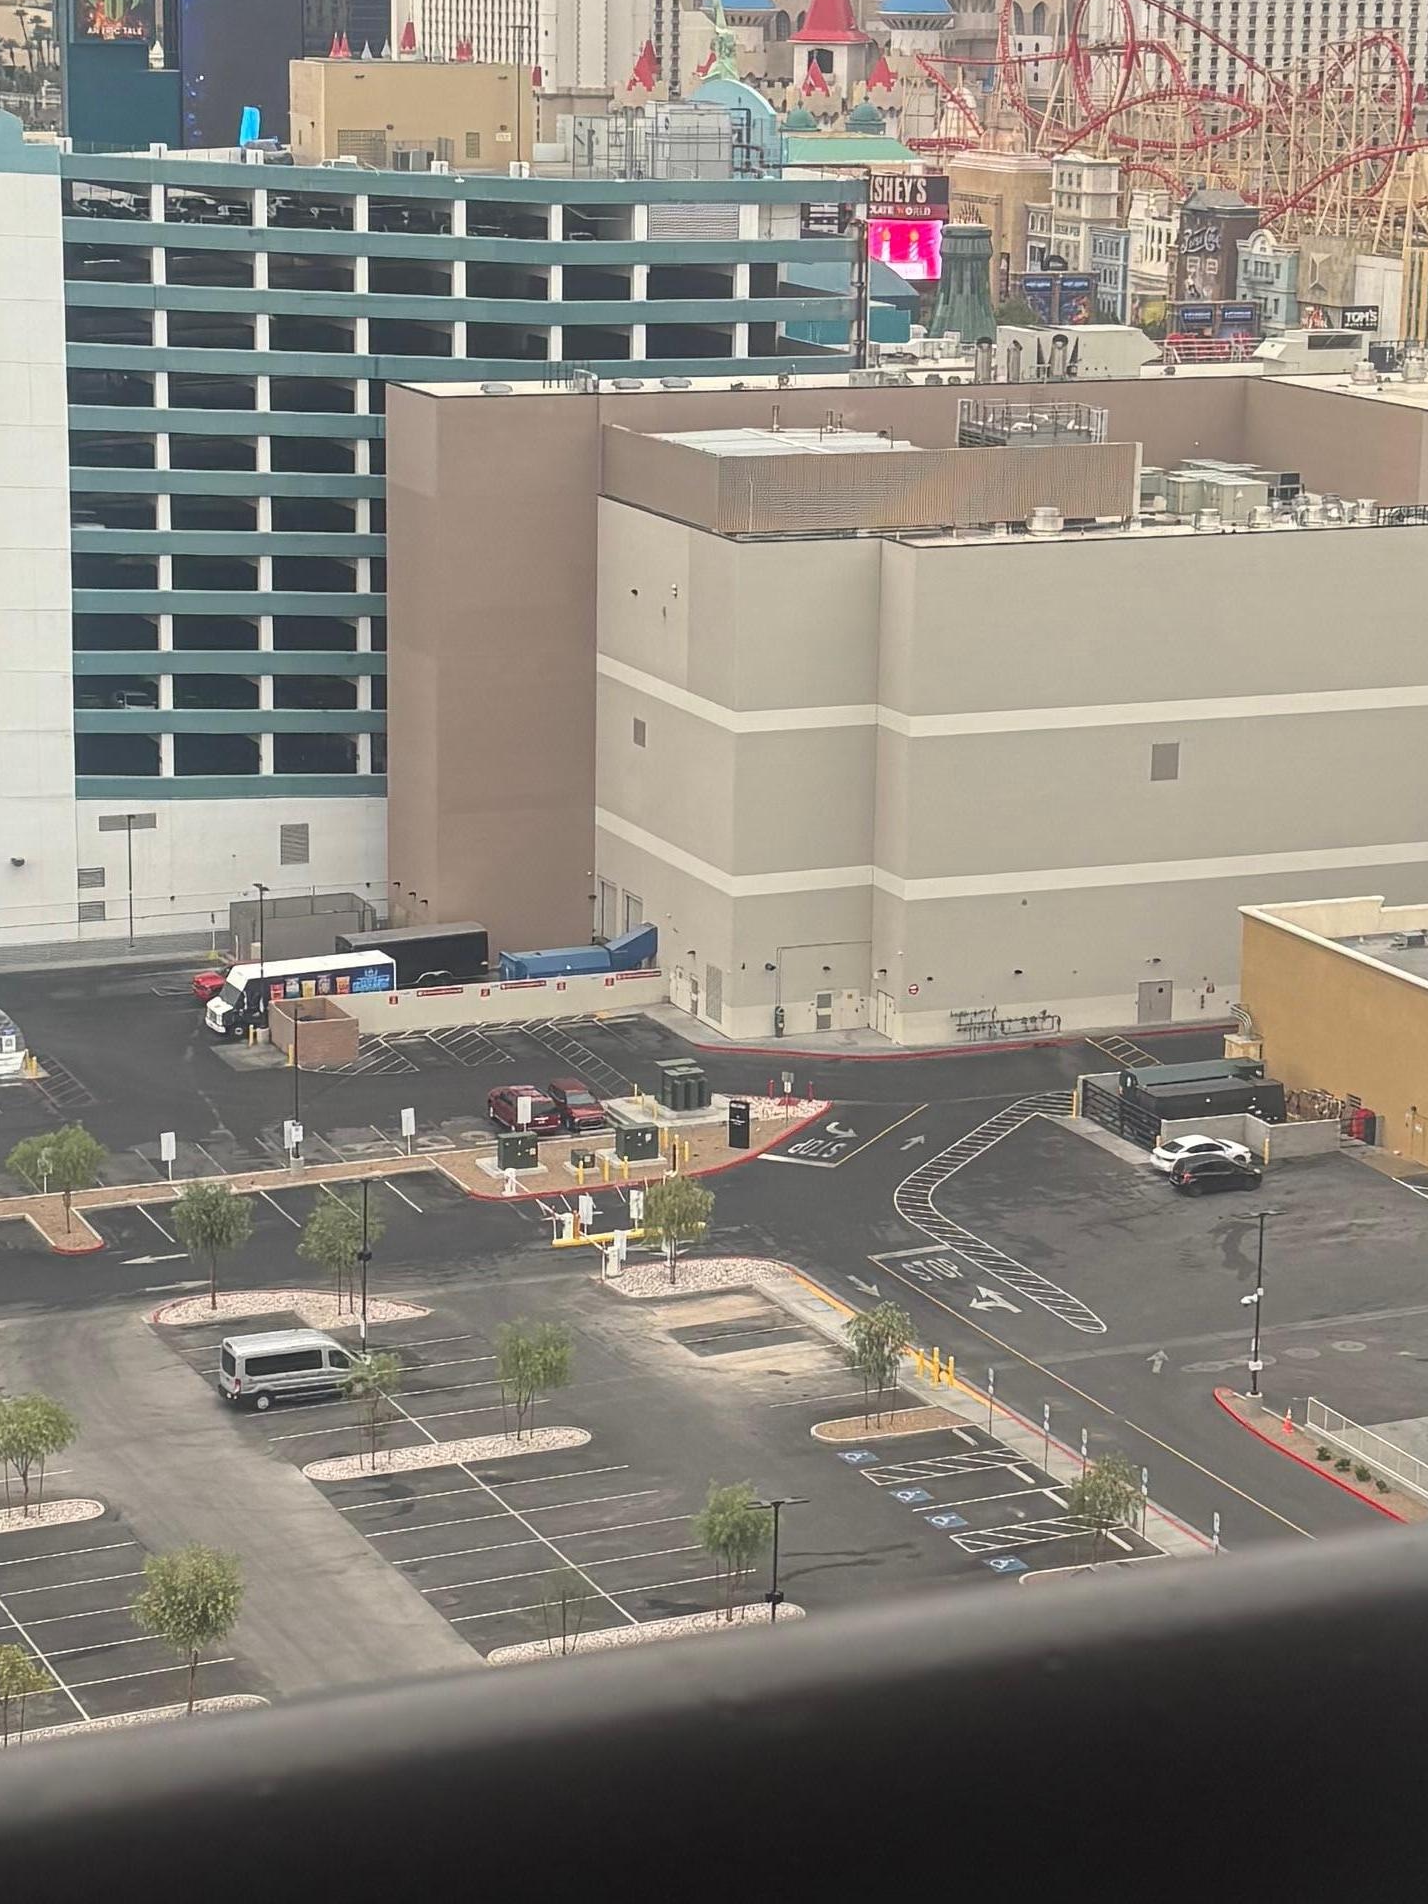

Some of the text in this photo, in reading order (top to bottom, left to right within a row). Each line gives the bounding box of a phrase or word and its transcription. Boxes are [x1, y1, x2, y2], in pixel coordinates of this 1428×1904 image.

[870, 176, 927, 203] SHEY'S
[787, 1137, 847, 1158] STOP
[901, 1257, 964, 1283] STOP
